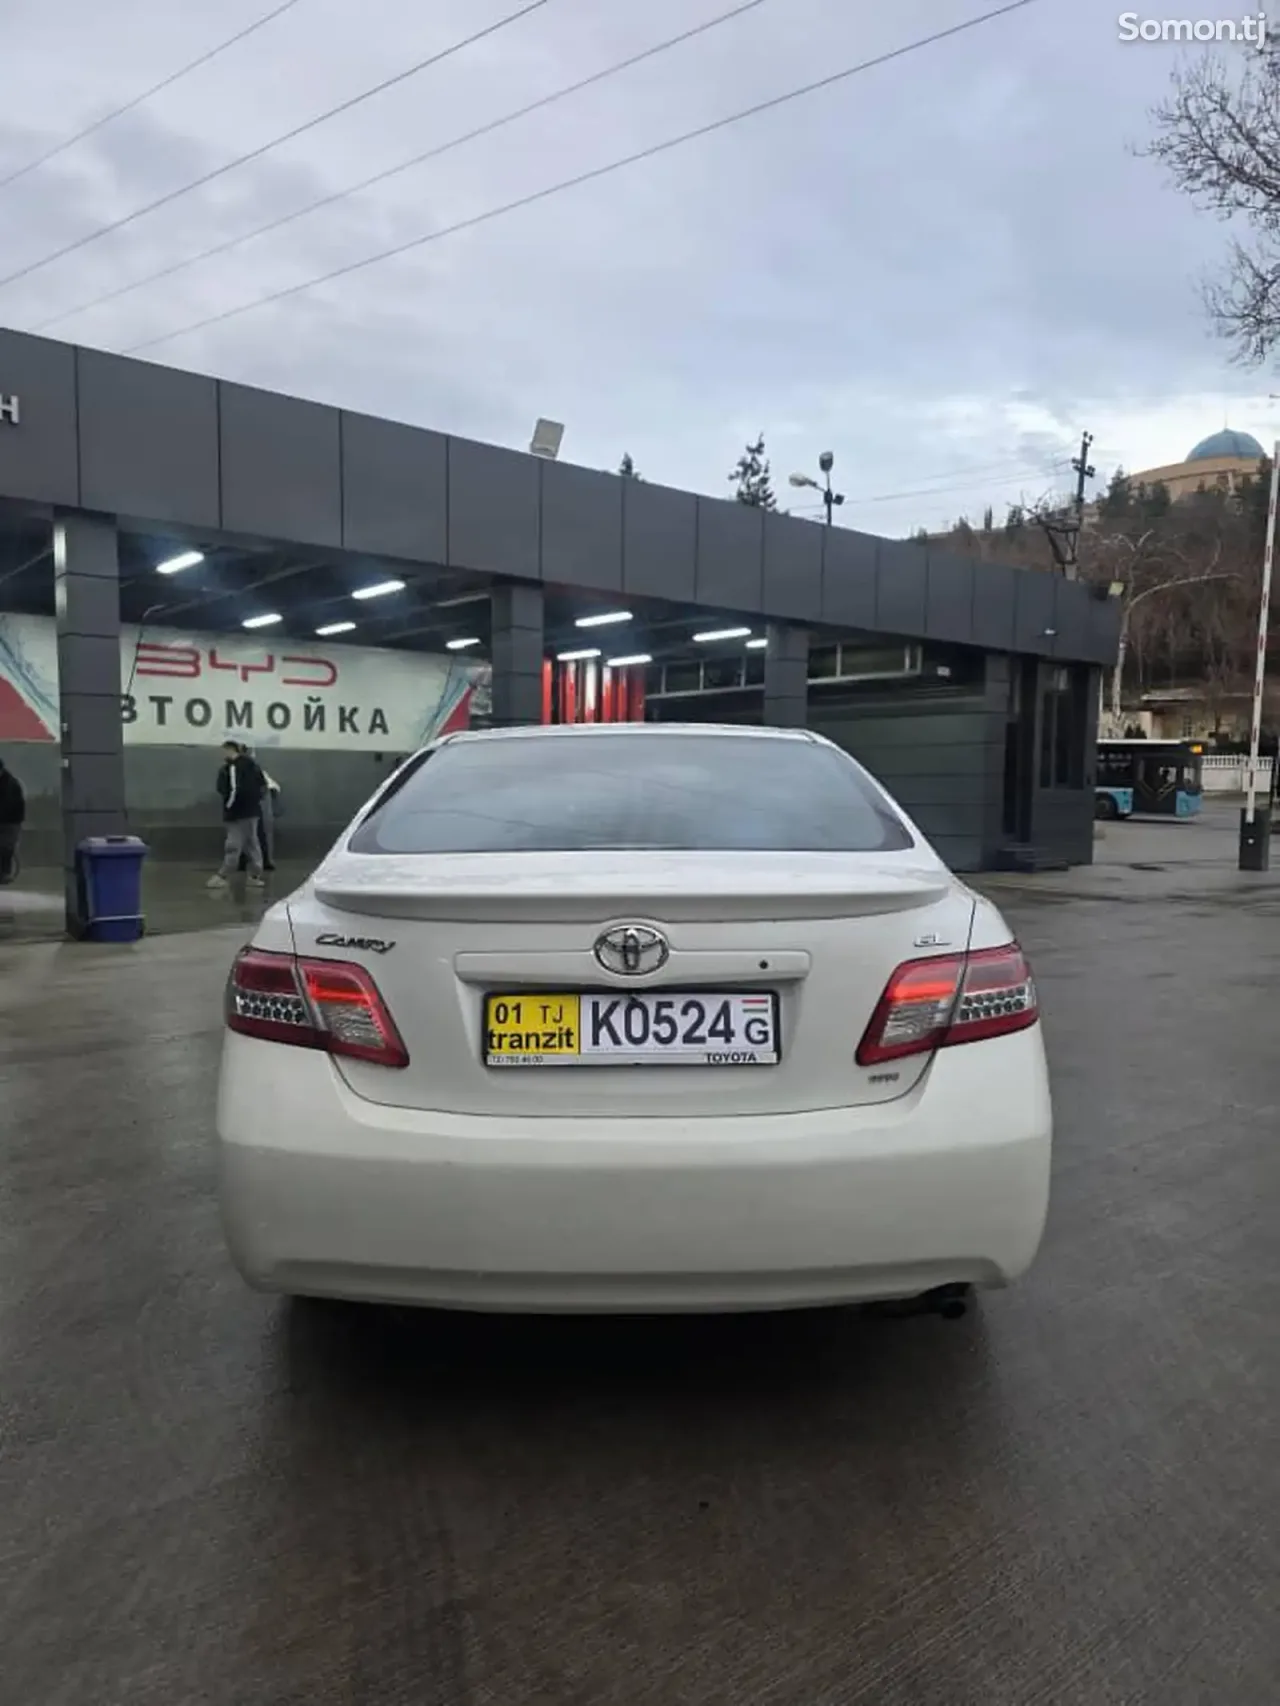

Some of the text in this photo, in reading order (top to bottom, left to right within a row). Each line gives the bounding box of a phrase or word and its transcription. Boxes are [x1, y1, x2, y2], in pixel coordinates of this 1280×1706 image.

[136, 643, 337, 686] BYD
[120, 694, 390, 735] ВТОМОЙКА
[495, 1003, 564, 1025] 01 TJ
[591, 999, 770, 1047] K0524 G
[488, 1027, 574, 1050] tranzit
[705, 1051, 757, 1063] TOYOTA
